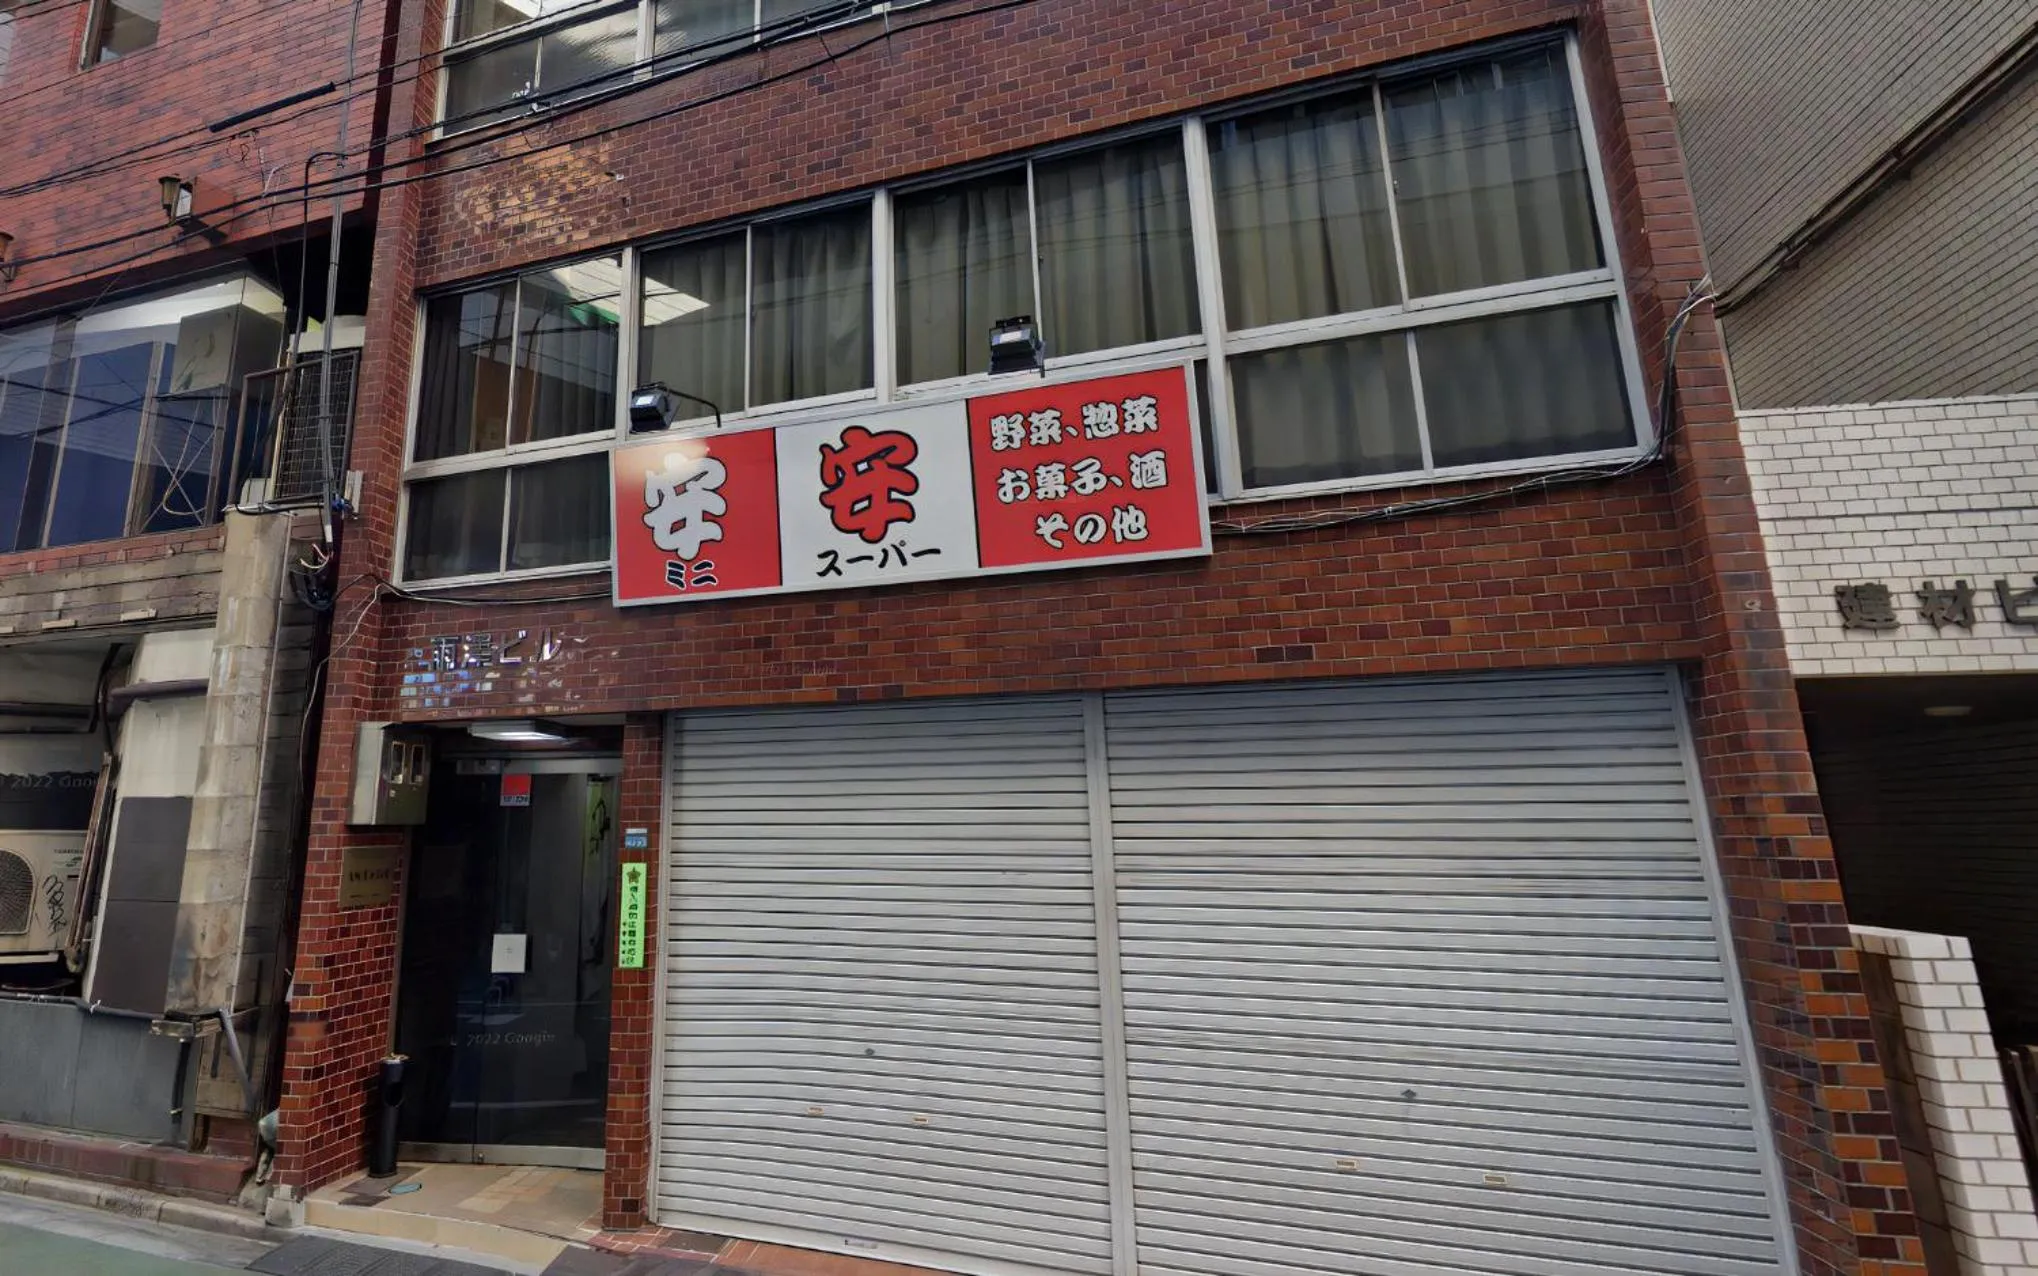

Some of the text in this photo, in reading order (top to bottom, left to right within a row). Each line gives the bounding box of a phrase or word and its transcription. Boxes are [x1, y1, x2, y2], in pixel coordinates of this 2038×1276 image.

[990, 395, 1159, 451] 野菜、惣菜
[819, 425, 919, 543] 安
[996, 450, 1168, 504] お菓子、酒
[643, 451, 727, 560] 安
[1034, 504, 1149, 549] その他
[665, 559, 718, 589] ミニ
[816, 539, 942, 577] スーパー
